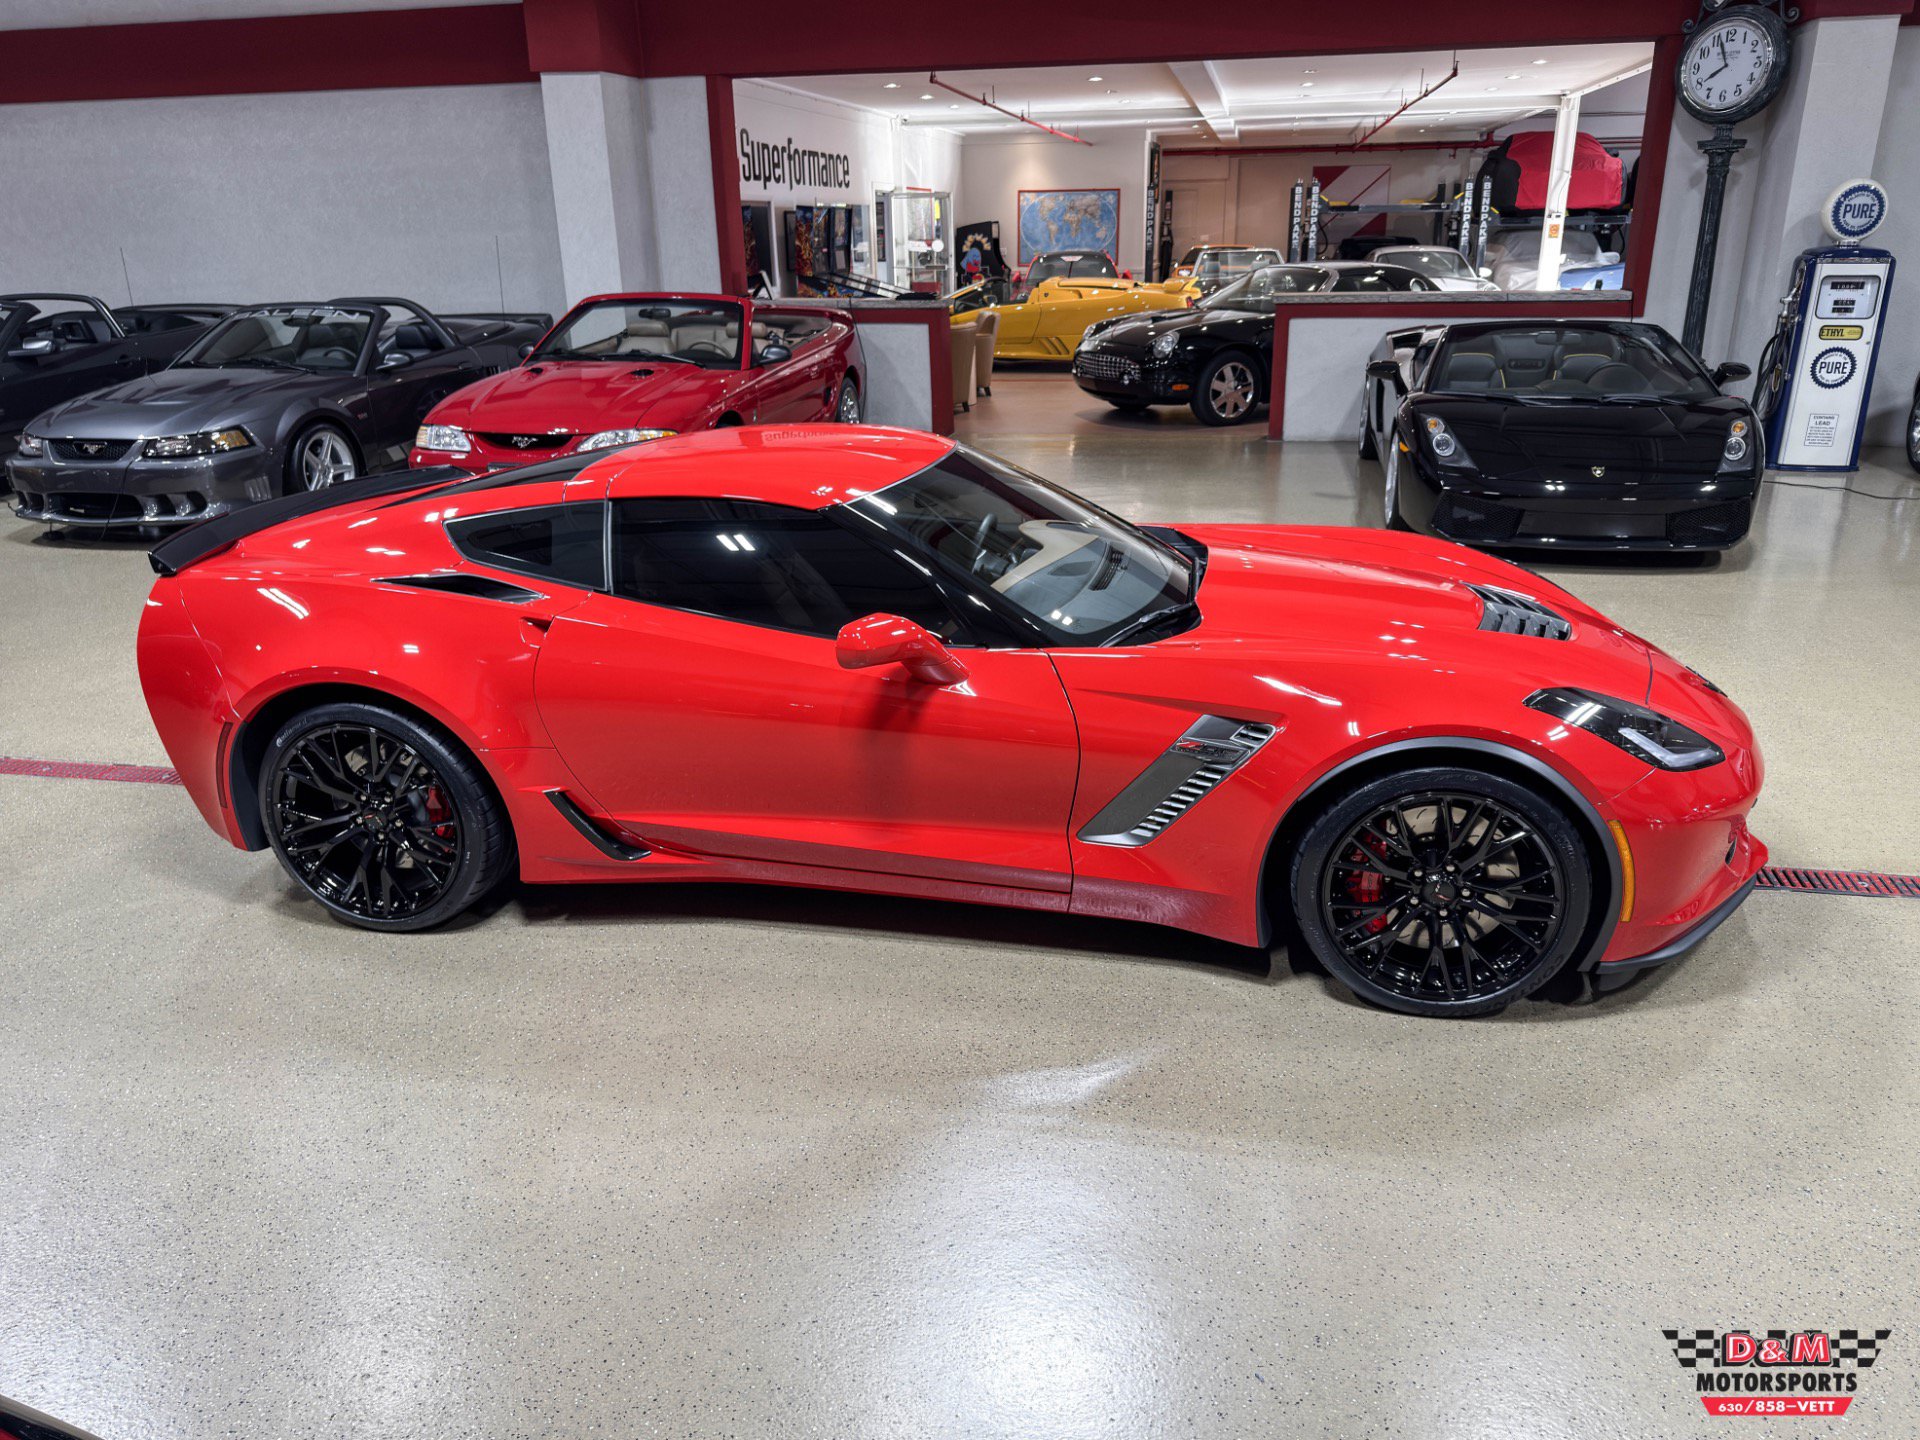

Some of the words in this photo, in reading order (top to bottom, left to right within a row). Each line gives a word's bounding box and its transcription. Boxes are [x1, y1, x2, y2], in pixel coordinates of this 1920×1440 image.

[1712, 34, 1720, 48] 11
[1725, 28, 1737, 43] 12
[1742, 31, 1747, 44] 1
[1700, 46, 1710, 60] 10
[1750, 40, 1759, 53] 2
[1753, 56, 1762, 68] 3
[1692, 63, 1700, 75] 9
[1695, 78, 1704, 90] 8
[1747, 72, 1756, 84] 4
[1706, 87, 1713, 100] 7
[1719, 90, 1727, 102] 6
[1734, 84, 1742, 97] 5
[740, 128, 850, 192] Superformance
[1842, 203, 1877, 220] PURE
[1820, 328, 1845, 337] ETHYL
[1818, 361, 1849, 374] PURE
